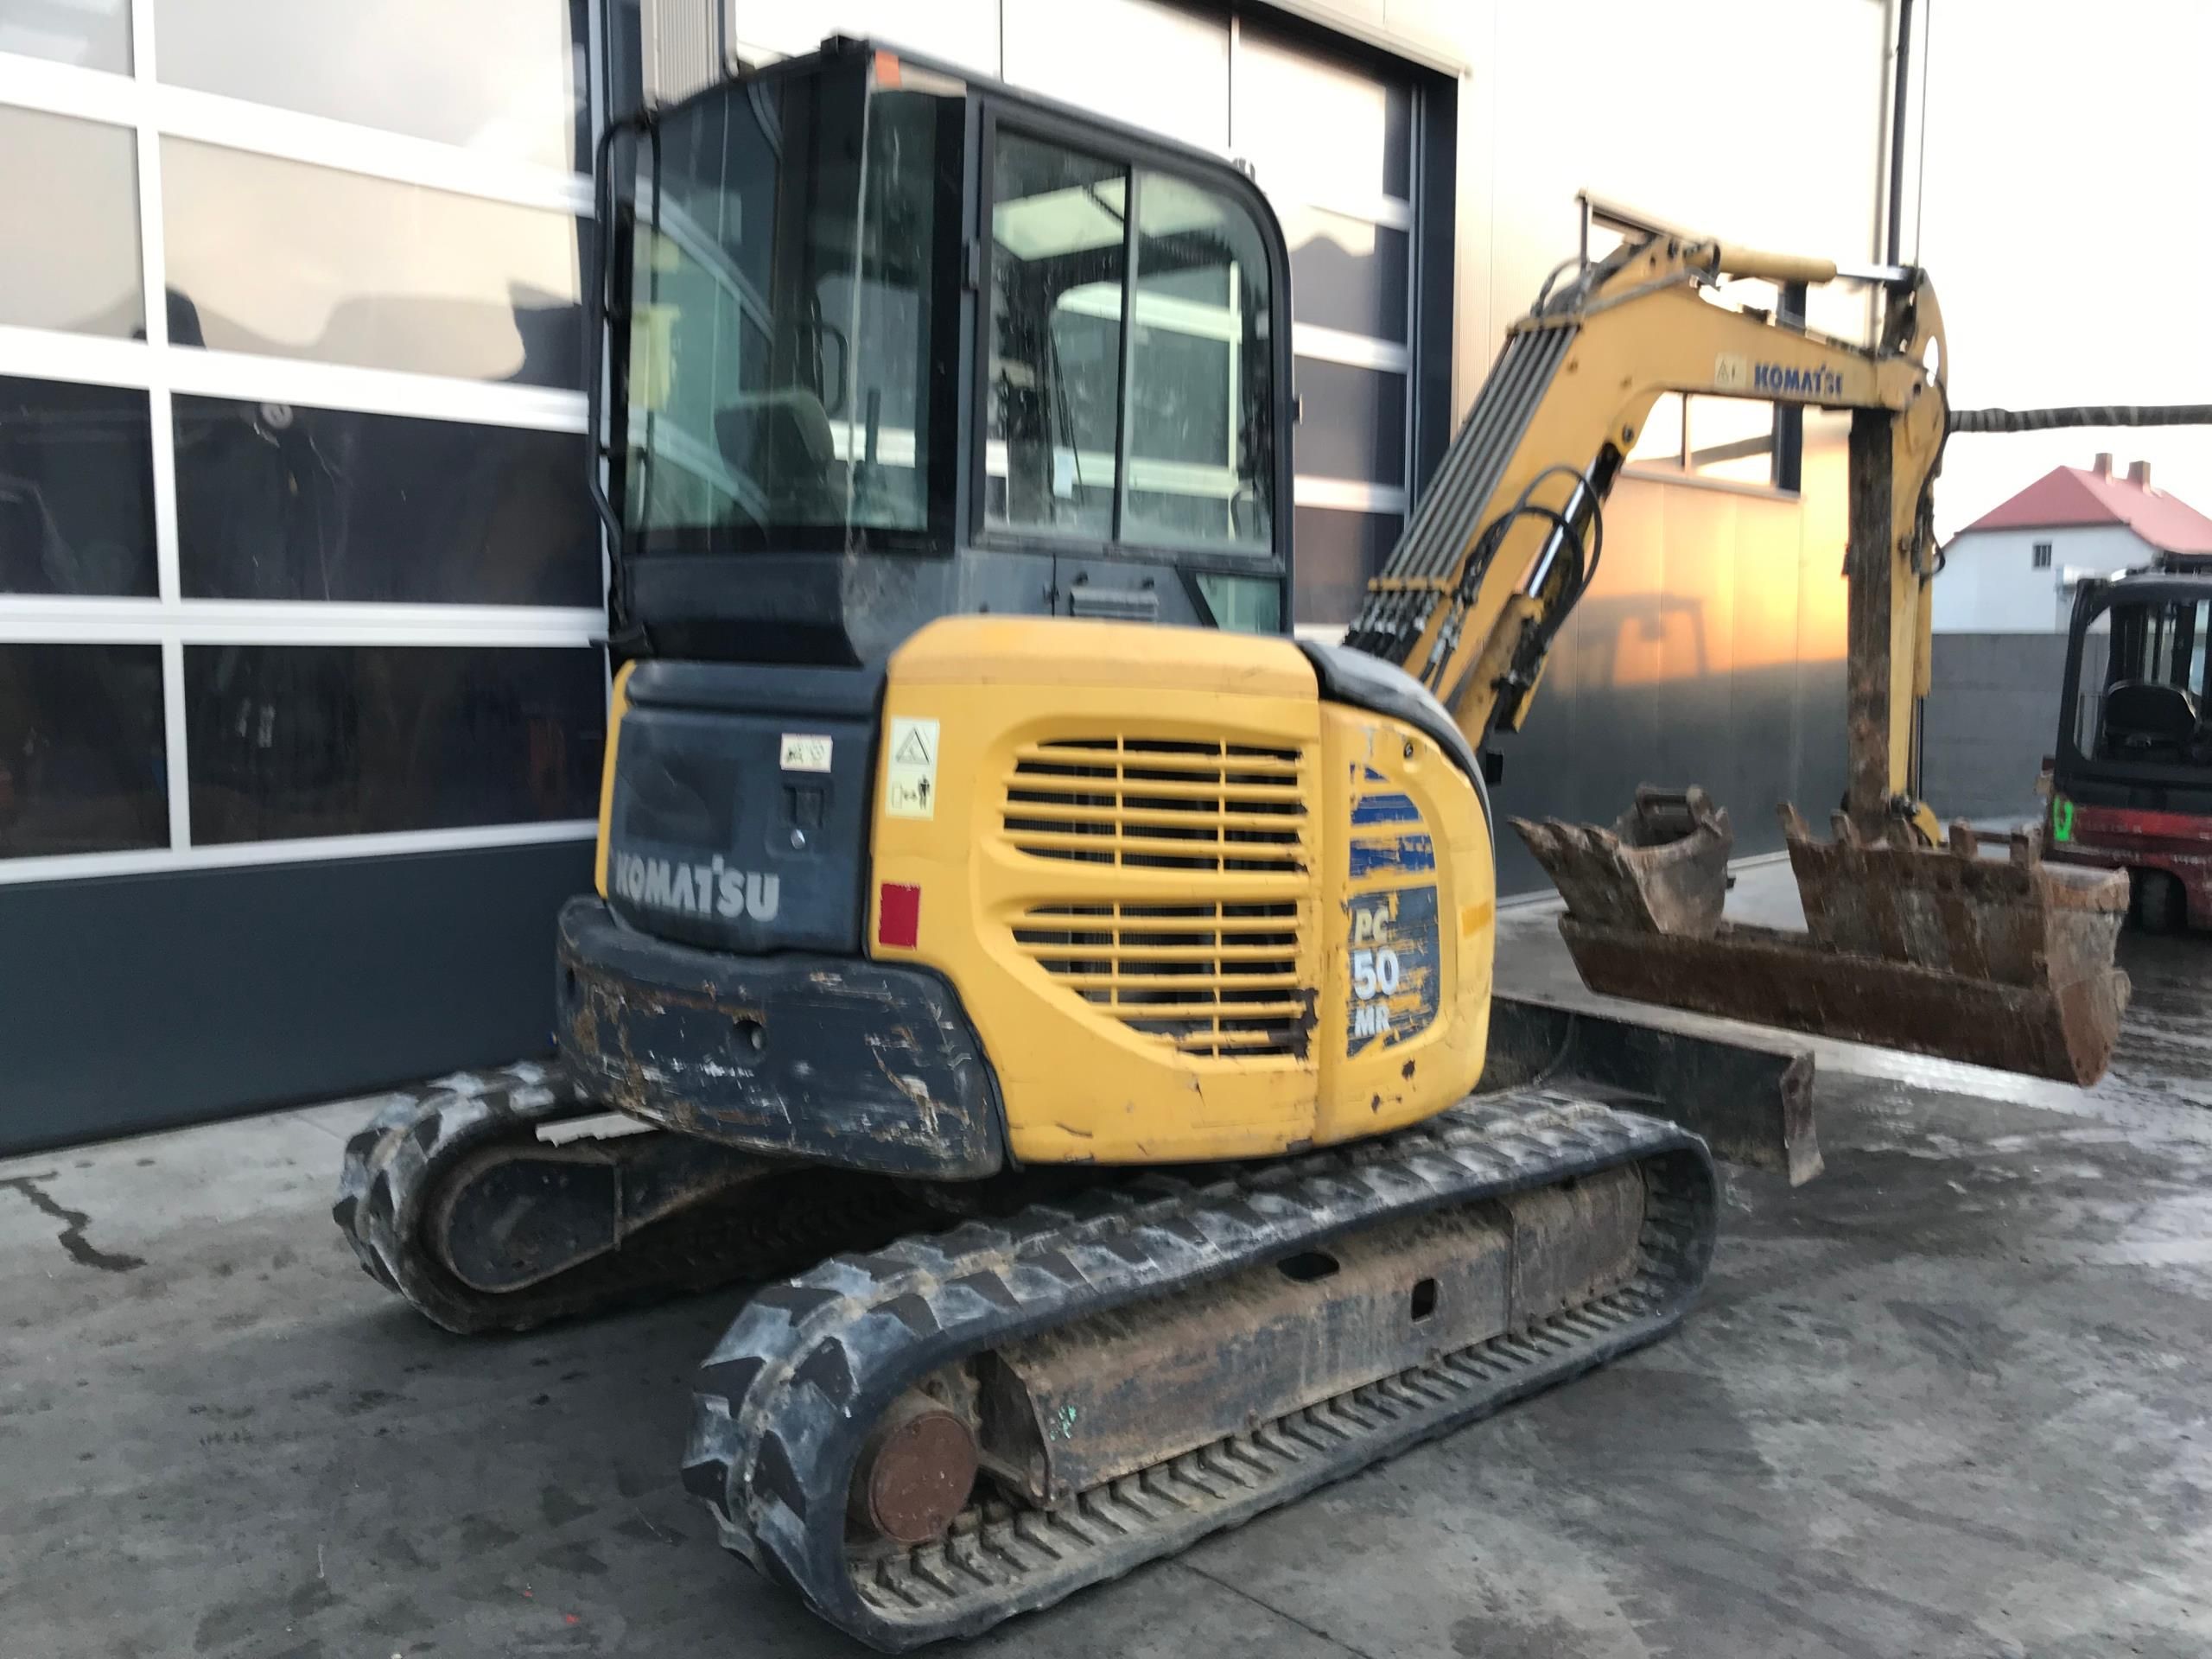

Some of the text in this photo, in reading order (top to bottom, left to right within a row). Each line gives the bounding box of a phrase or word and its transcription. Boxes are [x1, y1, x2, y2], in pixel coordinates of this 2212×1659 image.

[616, 850, 779, 922] KOMATSU
[1355, 905, 1389, 944] PC
[1354, 947, 1399, 1000] 50
